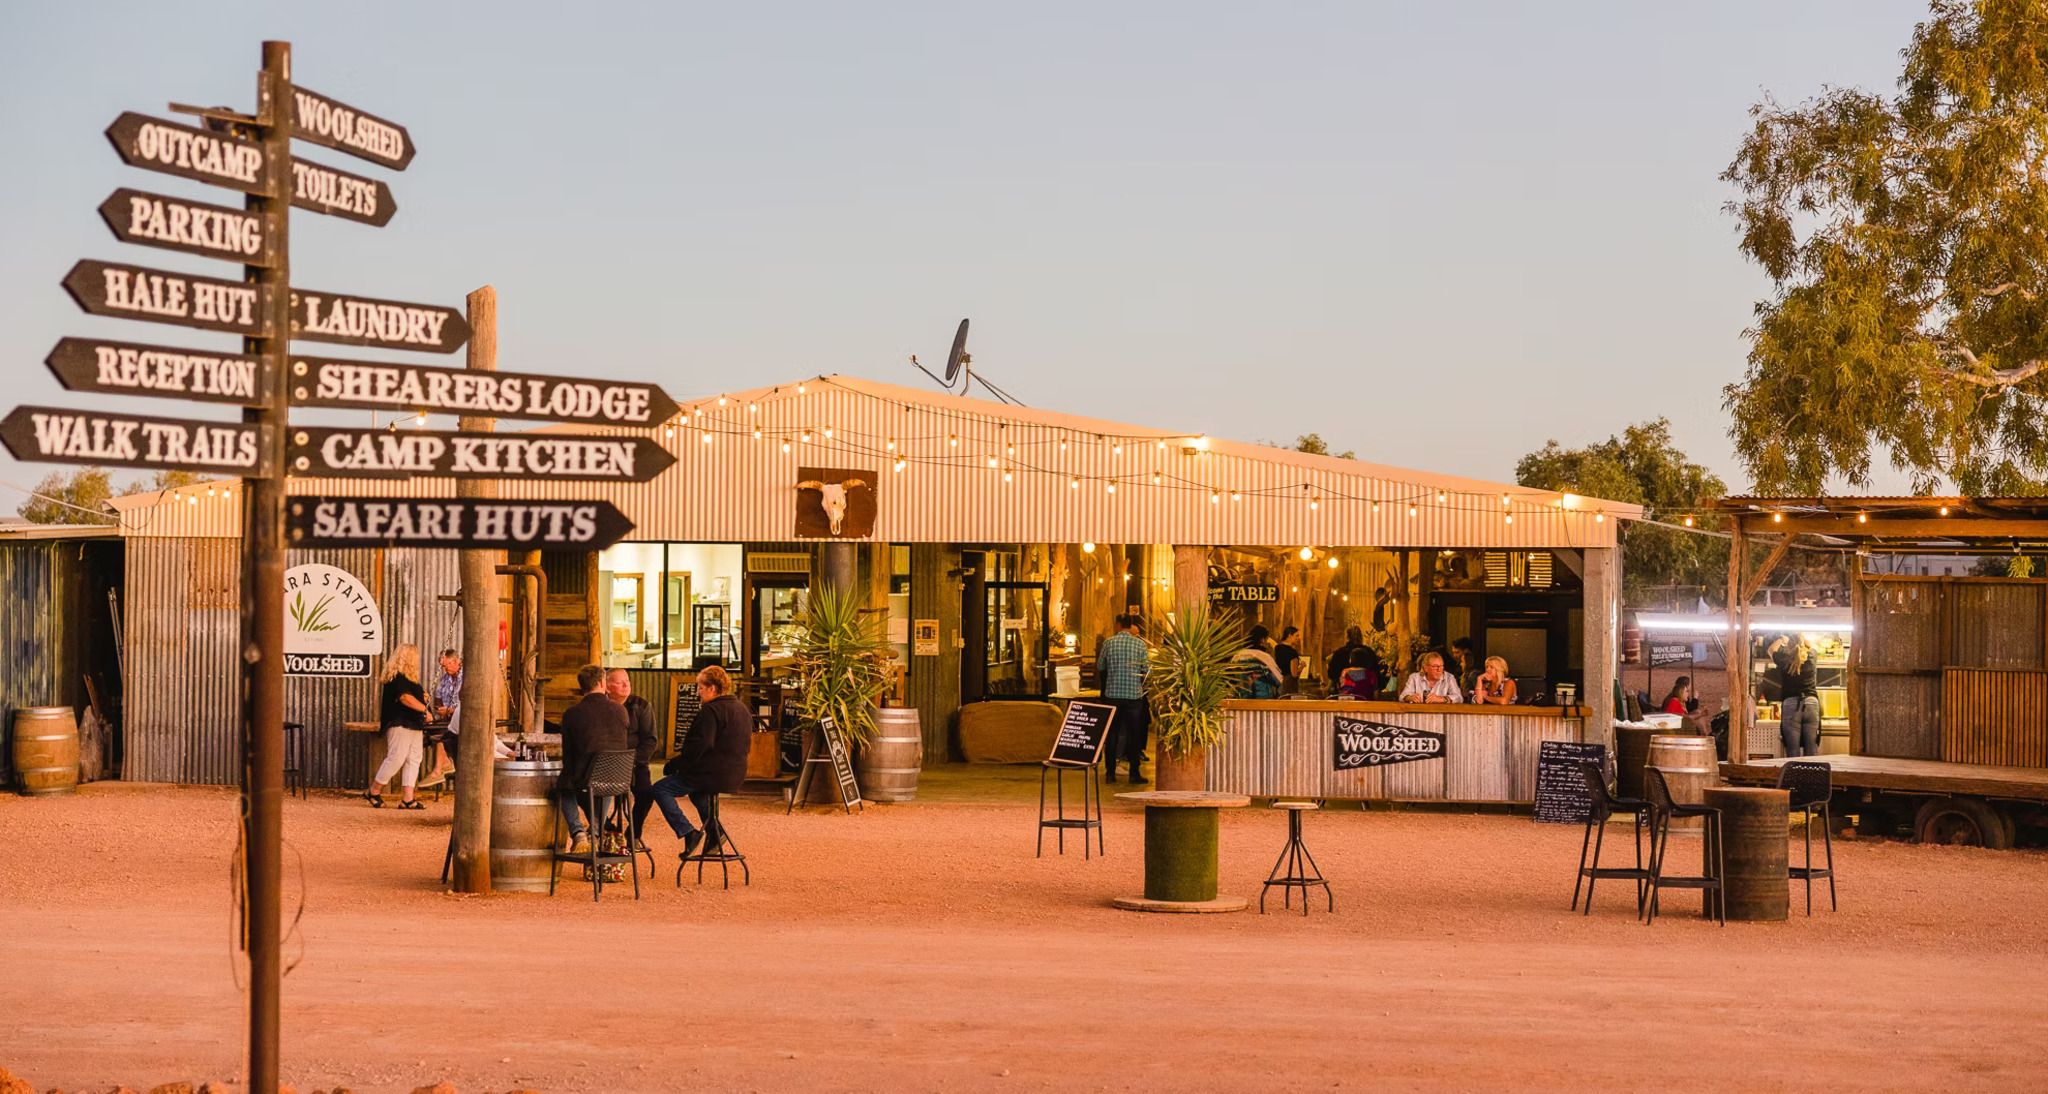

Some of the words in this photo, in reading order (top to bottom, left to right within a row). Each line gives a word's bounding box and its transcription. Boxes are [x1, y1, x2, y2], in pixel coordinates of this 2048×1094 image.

[138, 122, 263, 184] OUTCAMP
[295, 92, 404, 161] WOOLSHED
[293, 163, 377, 217] TOILETS
[129, 197, 261, 256] PARKING
[104, 268, 188, 319] HALE
[194, 282, 257, 325] HUT
[304, 296, 449, 346] LAUNDRY
[96, 346, 256, 398] RECEPTION
[316, 363, 523, 414] SHEARERS
[526, 381, 651, 421] LODGE
[32, 412, 138, 460] WALK
[141, 424, 257, 469] TRAILS
[320, 433, 445, 472] CAMP
[451, 438, 636, 478] KITCHEN
[313, 501, 463, 538] SAFARI
[474, 504, 597, 543] HUTS
[322, 573, 375, 641] STATION
[1228, 586, 1276, 601] TABLE
[1338, 734, 1440, 752] WOOLSHED
